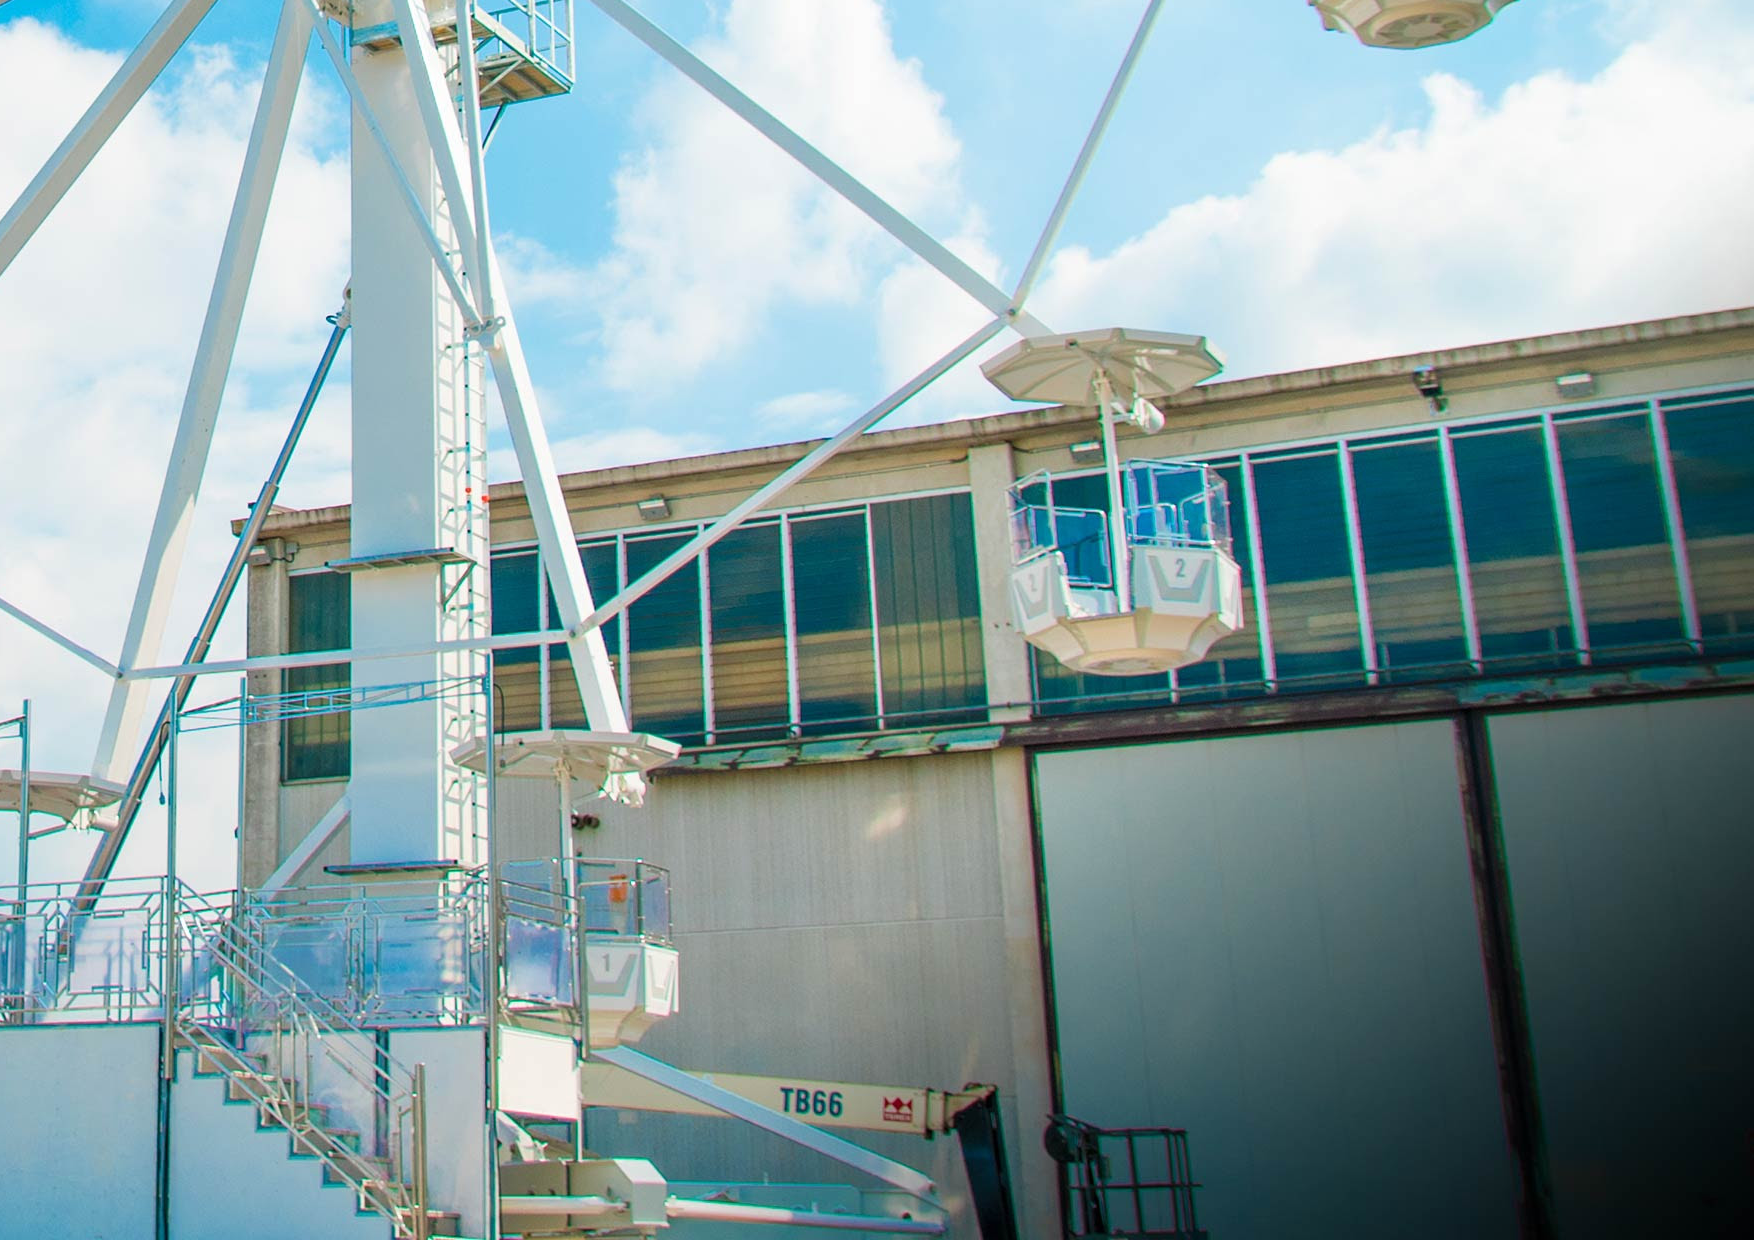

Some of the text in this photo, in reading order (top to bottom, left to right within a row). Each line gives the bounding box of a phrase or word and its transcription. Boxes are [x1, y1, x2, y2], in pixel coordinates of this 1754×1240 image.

[1175, 558, 1186, 578] 2
[1027, 574, 1037, 592] 2
[601, 953, 611, 972] 1
[780, 1087, 843, 1118] TB66
